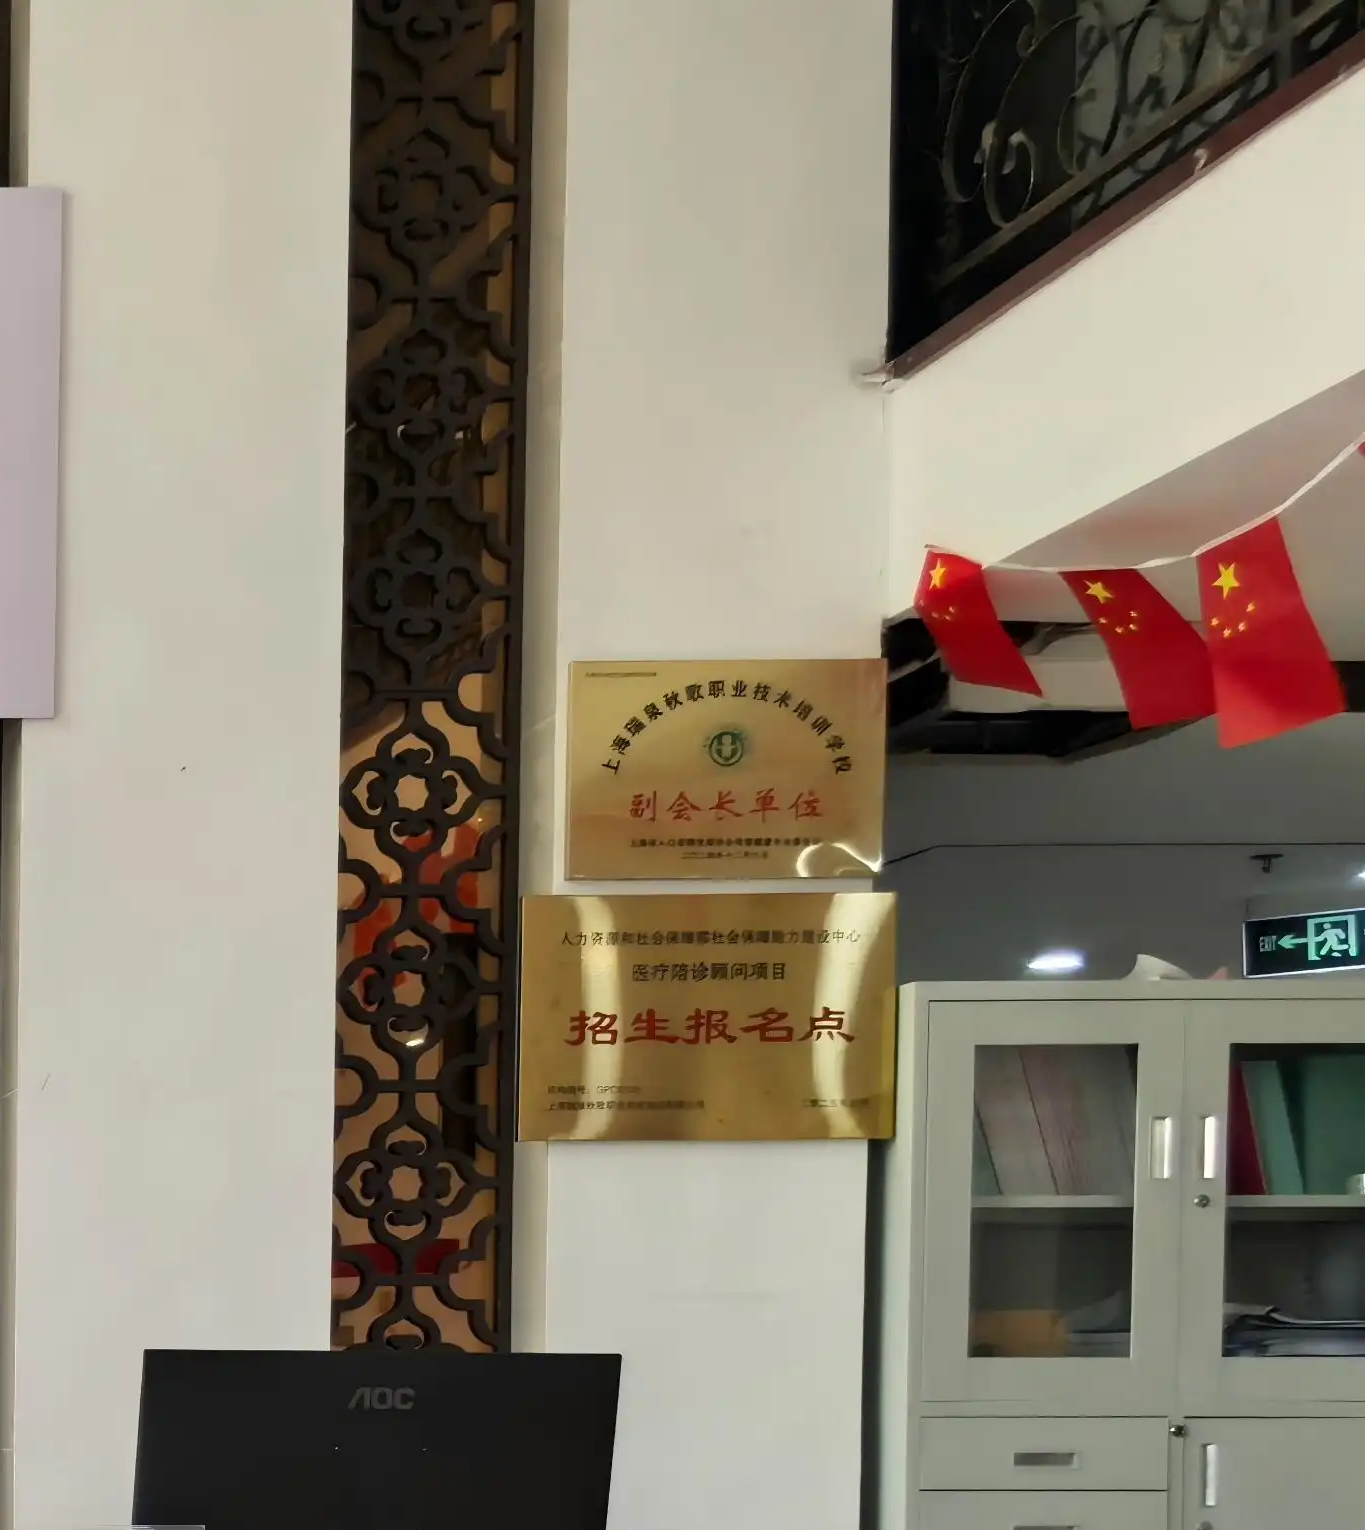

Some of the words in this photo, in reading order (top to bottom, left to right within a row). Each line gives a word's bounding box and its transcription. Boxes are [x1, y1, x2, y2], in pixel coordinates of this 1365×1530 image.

[628, 788, 824, 823] 副会长单位
[1259, 935, 1277, 953] EXIT
[632, 962, 786, 983] 医疗陪诊顾问项目
[564, 1006, 855, 1047] 招生报名点
[348, 1387, 416, 1411] AOC
